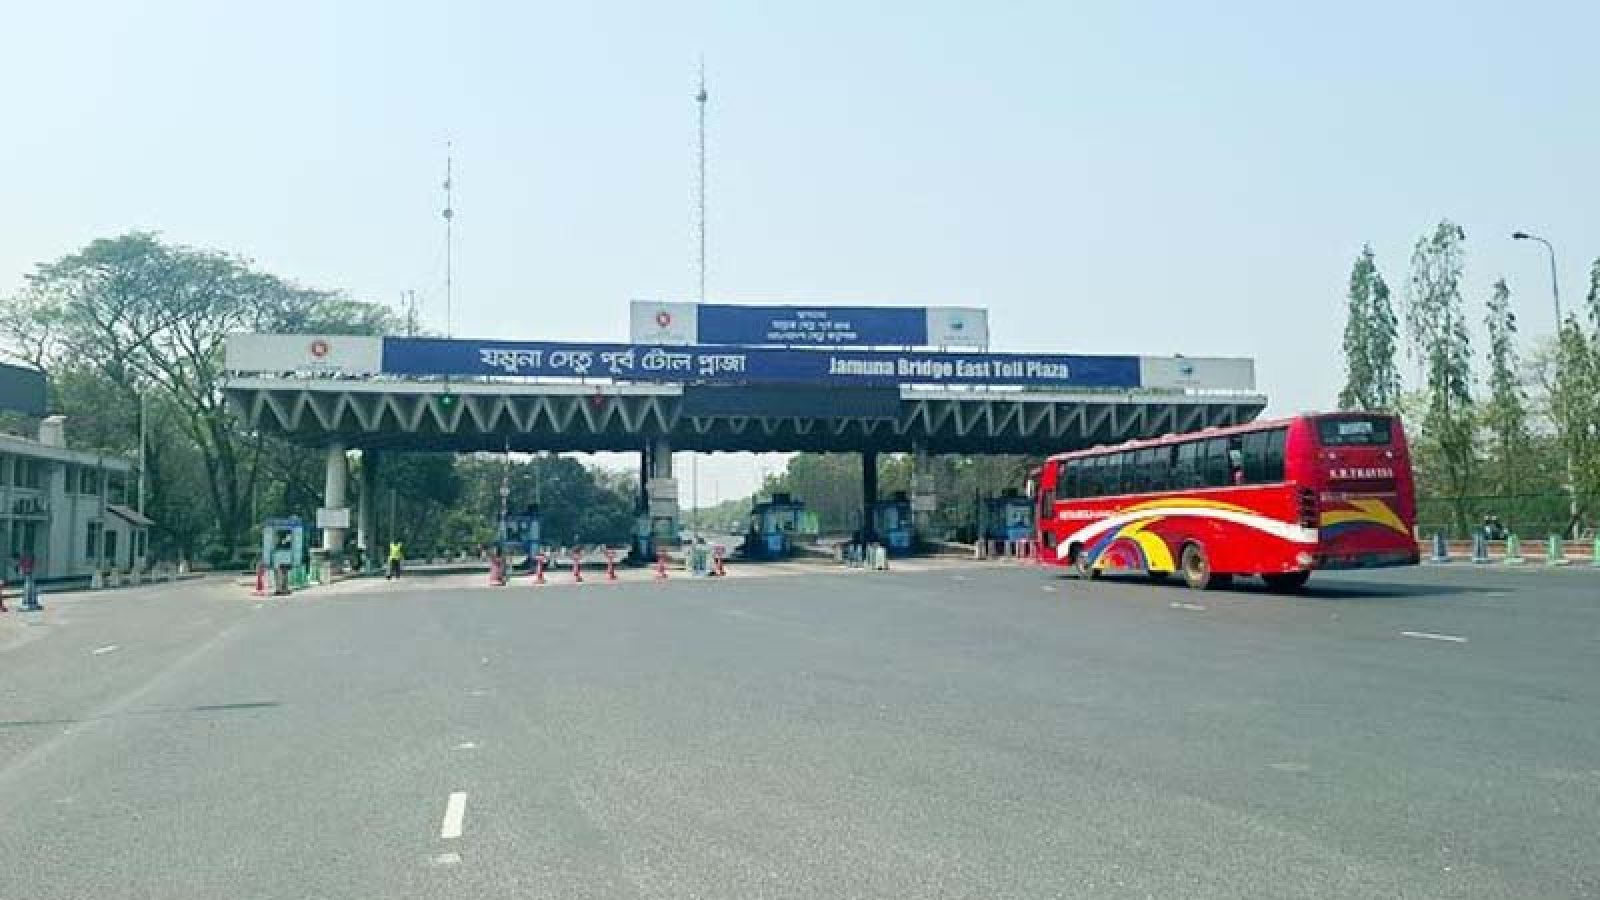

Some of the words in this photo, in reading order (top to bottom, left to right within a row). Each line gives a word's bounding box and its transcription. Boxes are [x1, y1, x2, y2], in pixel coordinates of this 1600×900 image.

[480, 349, 543, 373] যমুনা
[549, 351, 592, 374] সেতু
[600, 347, 635, 374] পূর্ব
[641, 347, 690, 371] টোল
[698, 355, 745, 376] প্লাজা
[829, 357, 895, 375] Jamuna
[898, 358, 952, 378] Bridge
[956, 359, 991, 377] East
[992, 360, 1024, 378] Toll
[1027, 361, 1068, 379] Plaza
